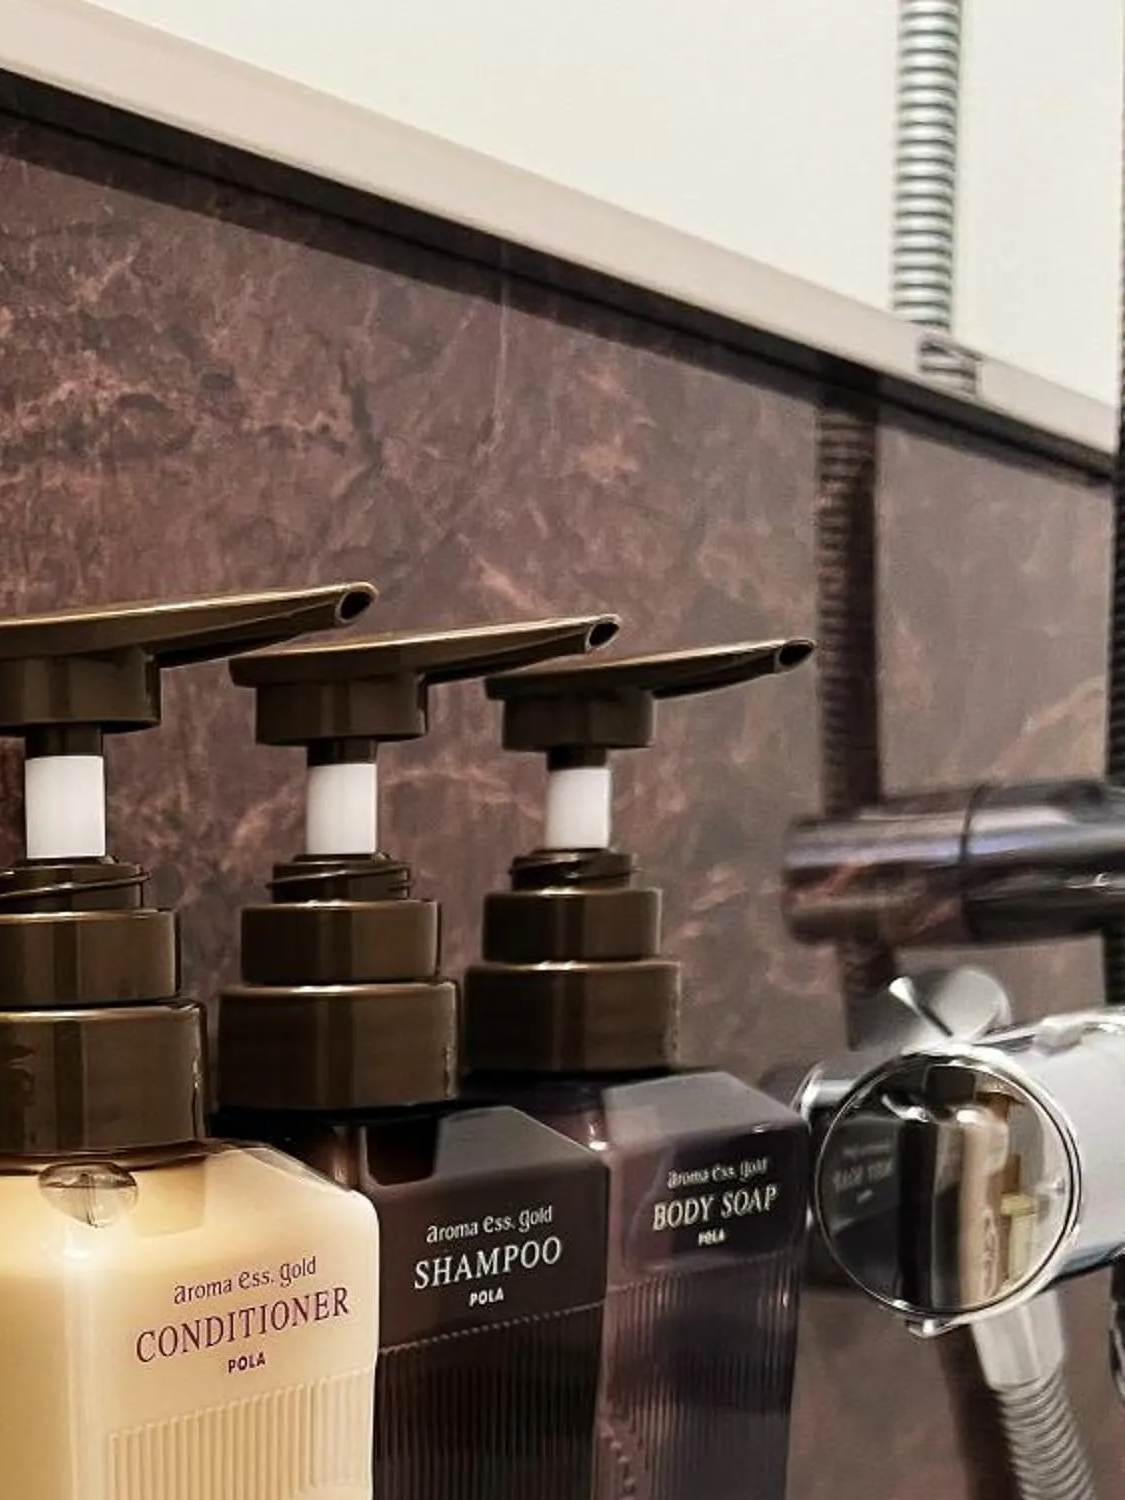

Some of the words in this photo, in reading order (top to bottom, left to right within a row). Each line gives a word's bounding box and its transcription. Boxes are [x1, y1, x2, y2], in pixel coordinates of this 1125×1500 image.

[426, 1221, 478, 1243] aroma
[482, 1215, 516, 1233] ess.
[518, 1205, 552, 1233] gold
[653, 1194, 715, 1231] BODY
[720, 1183, 778, 1219] SOAP
[698, 1227, 725, 1246] POLA
[173, 1278, 232, 1304] aroma
[238, 1271, 275, 1289] ess.
[279, 1255, 317, 1287] gold
[414, 1235, 562, 1290] SHAMPOO
[469, 1287, 504, 1307] POLA
[136, 1287, 350, 1363] CONDITIONER
[228, 1352, 266, 1373] POLA
